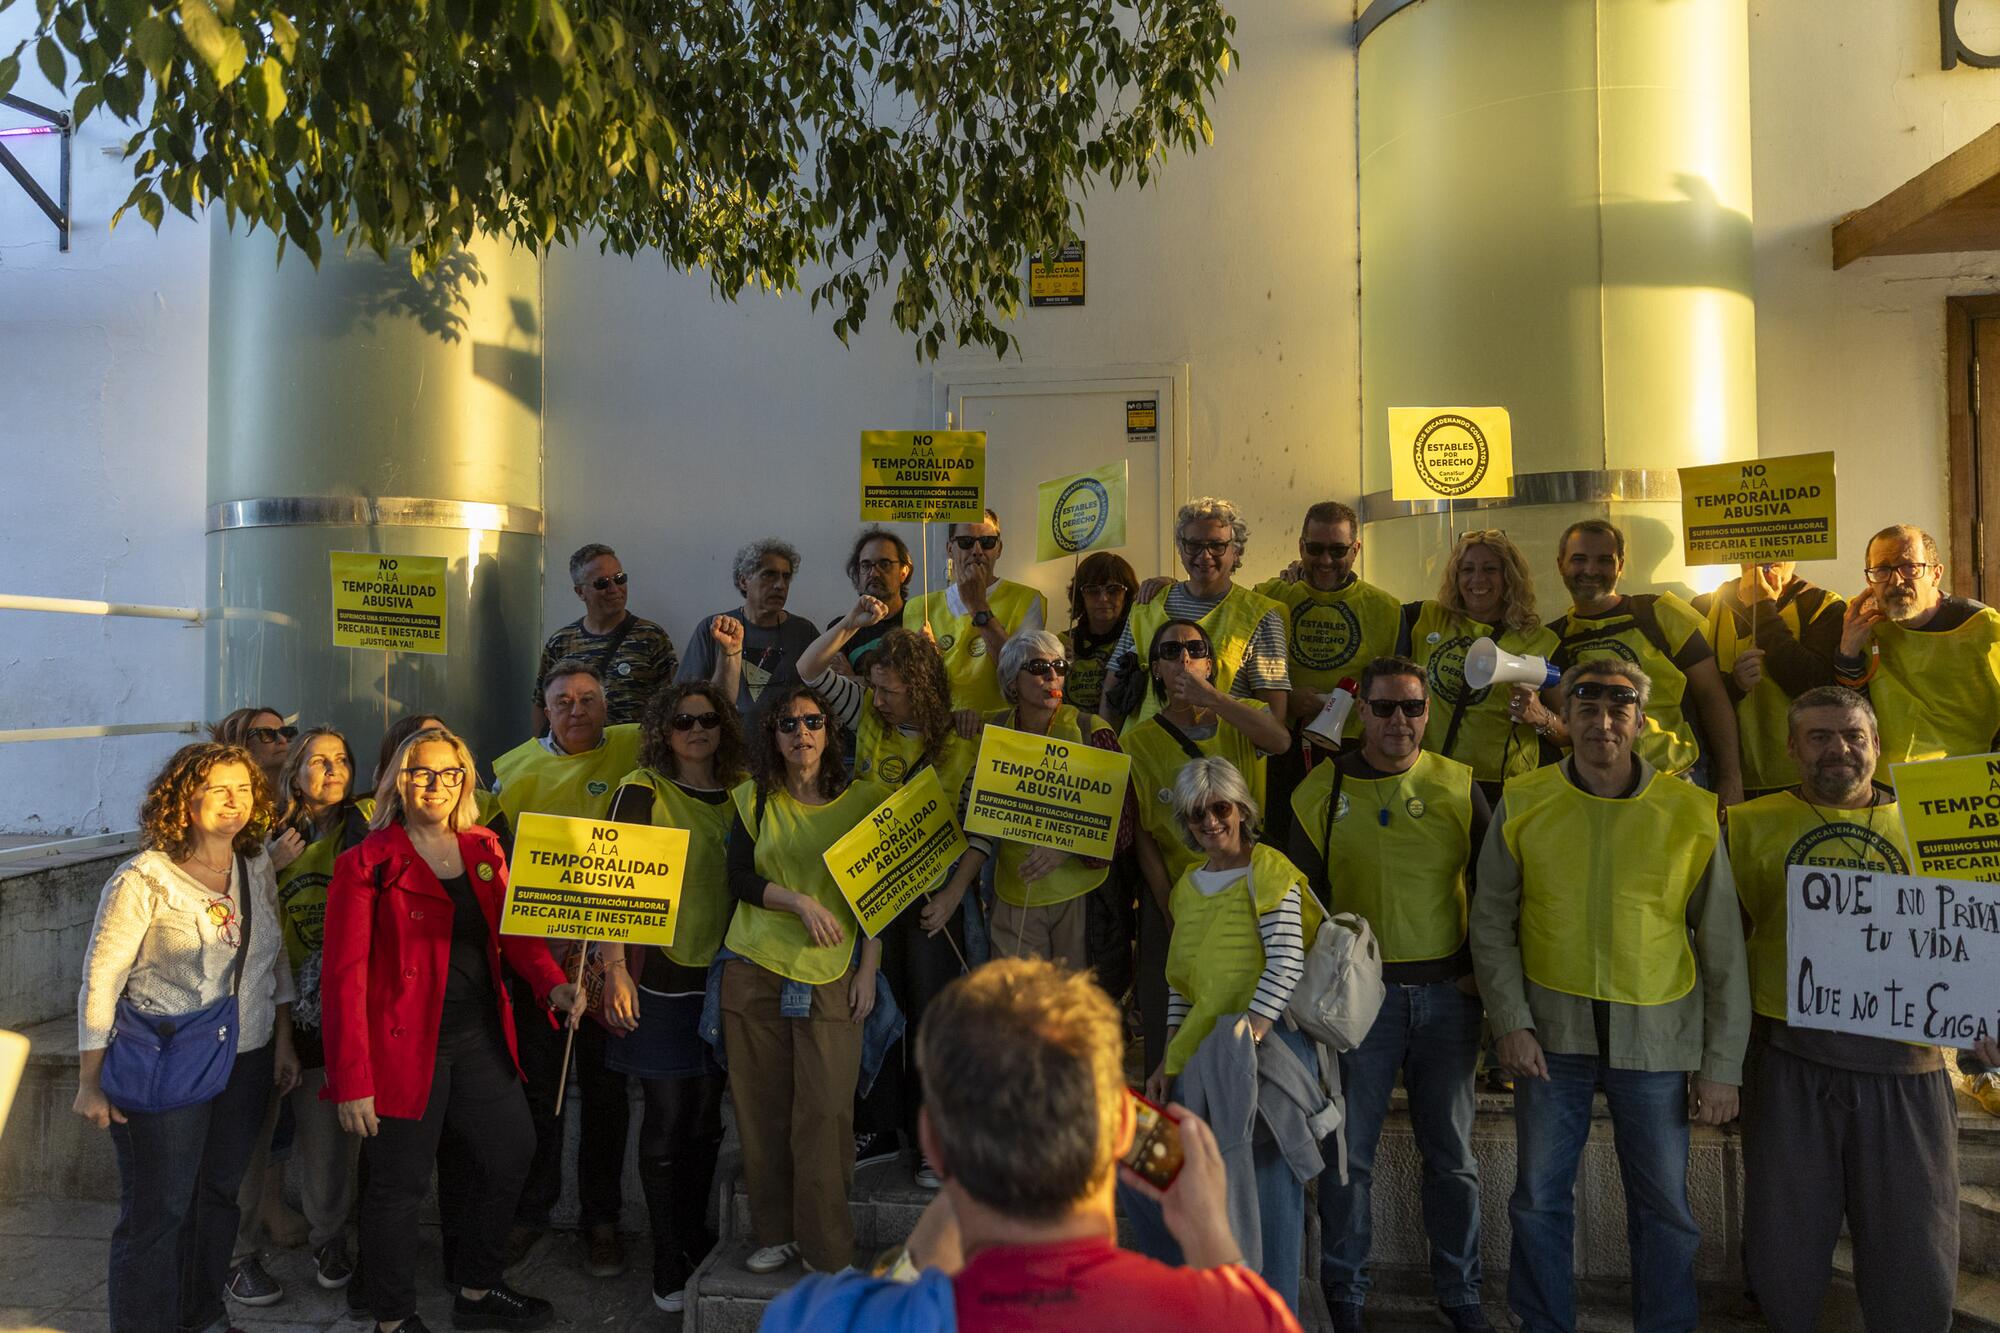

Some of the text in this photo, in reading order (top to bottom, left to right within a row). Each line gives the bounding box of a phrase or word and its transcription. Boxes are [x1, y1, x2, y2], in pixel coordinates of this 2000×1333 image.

[913, 435, 932, 445] NO
[1424, 417, 1471, 434] ENCADENANDO
[1469, 426, 1487, 465] CONTRATOS
[1427, 442, 1474, 452] ESTABLES
[910, 447, 934, 456] A LA
[871, 458, 974, 469] TEMPORALIDAD
[1429, 458, 1473, 467] DERECHO
[1741, 463, 1766, 477] NO
[895, 470, 950, 481] ABUSIVA
[1739, 477, 1768, 490] A LA
[865, 499, 977, 508] PRECARIA E INESTABLE
[1694, 485, 1820, 507] TEMPORALIDAD
[891, 511, 950, 520] ¡¡JUSTICIA YA!!
[1063, 500, 1097, 515] ESTABLES
[1723, 502, 1790, 518] ABUSIVA
[1063, 515, 1096, 528] DERECHO
[1692, 521, 1824, 536] SUFRIMOS UNA SITUACIÓN LABORAL
[1689, 533, 1828, 550] PRECARIA E INESTABLE
[1721, 548, 1793, 561] ¡¡JUSTICIA YA!!
[378, 559, 397, 570] NO
[376, 571, 398, 582] A LA
[342, 580, 436, 597] TEMPORALIDAD
[362, 594, 413, 608] ABUSIVA
[337, 622, 440, 639] PRECARIA E INESTABLE
[360, 637, 414, 648] ¡¡JUSTICIA YA!!
[1044, 743, 1069, 758] NO
[1039, 756, 1068, 772] A LA
[992, 759, 1112, 795] TEMPORALIDAD
[1015, 779, 1081, 804] ABUSIVA
[871, 806, 893, 828] NO
[979, 794, 1107, 826] SUFRIMOS UNA SITUACIÓN LABORAL
[878, 816, 901, 840] A LA
[973, 805, 1108, 842] PRECARIA E INESTABLE
[1968, 811, 2000, 829] AB
[591, 826, 619, 841] NO
[846, 798, 938, 877] TEMPORALIDAD
[1002, 827, 1074, 847] ¡¡JUSTICIA YA!!
[586, 842, 619, 856] A LA
[875, 826, 926, 873] ABUSIVA
[1923, 841, 1980, 854] SUFRIMOS
[529, 850, 668, 876] TEMPORALIDAD
[859, 825, 951, 908] SUFRIMOS UNA SITUACIÓN LABORAL
[1921, 855, 2000, 872] PRECARI
[559, 869, 634, 889] ABUSIVA
[863, 832, 958, 921] PRECARIA E INESTABLE
[892, 861, 943, 912] ¡¡JUSTICIA YA!!
[1802, 872, 1872, 915] QUE
[1896, 887, 1925, 915] NO
[517, 890, 665, 910] SUFRIMOS UNA SITUACIÓN LABORAL
[511, 904, 666, 927] PRECARIA E INESTABLE
[546, 923, 629, 938] ¡¡JUSTICIA YA!!
[1850, 991, 1878, 1021] NO
